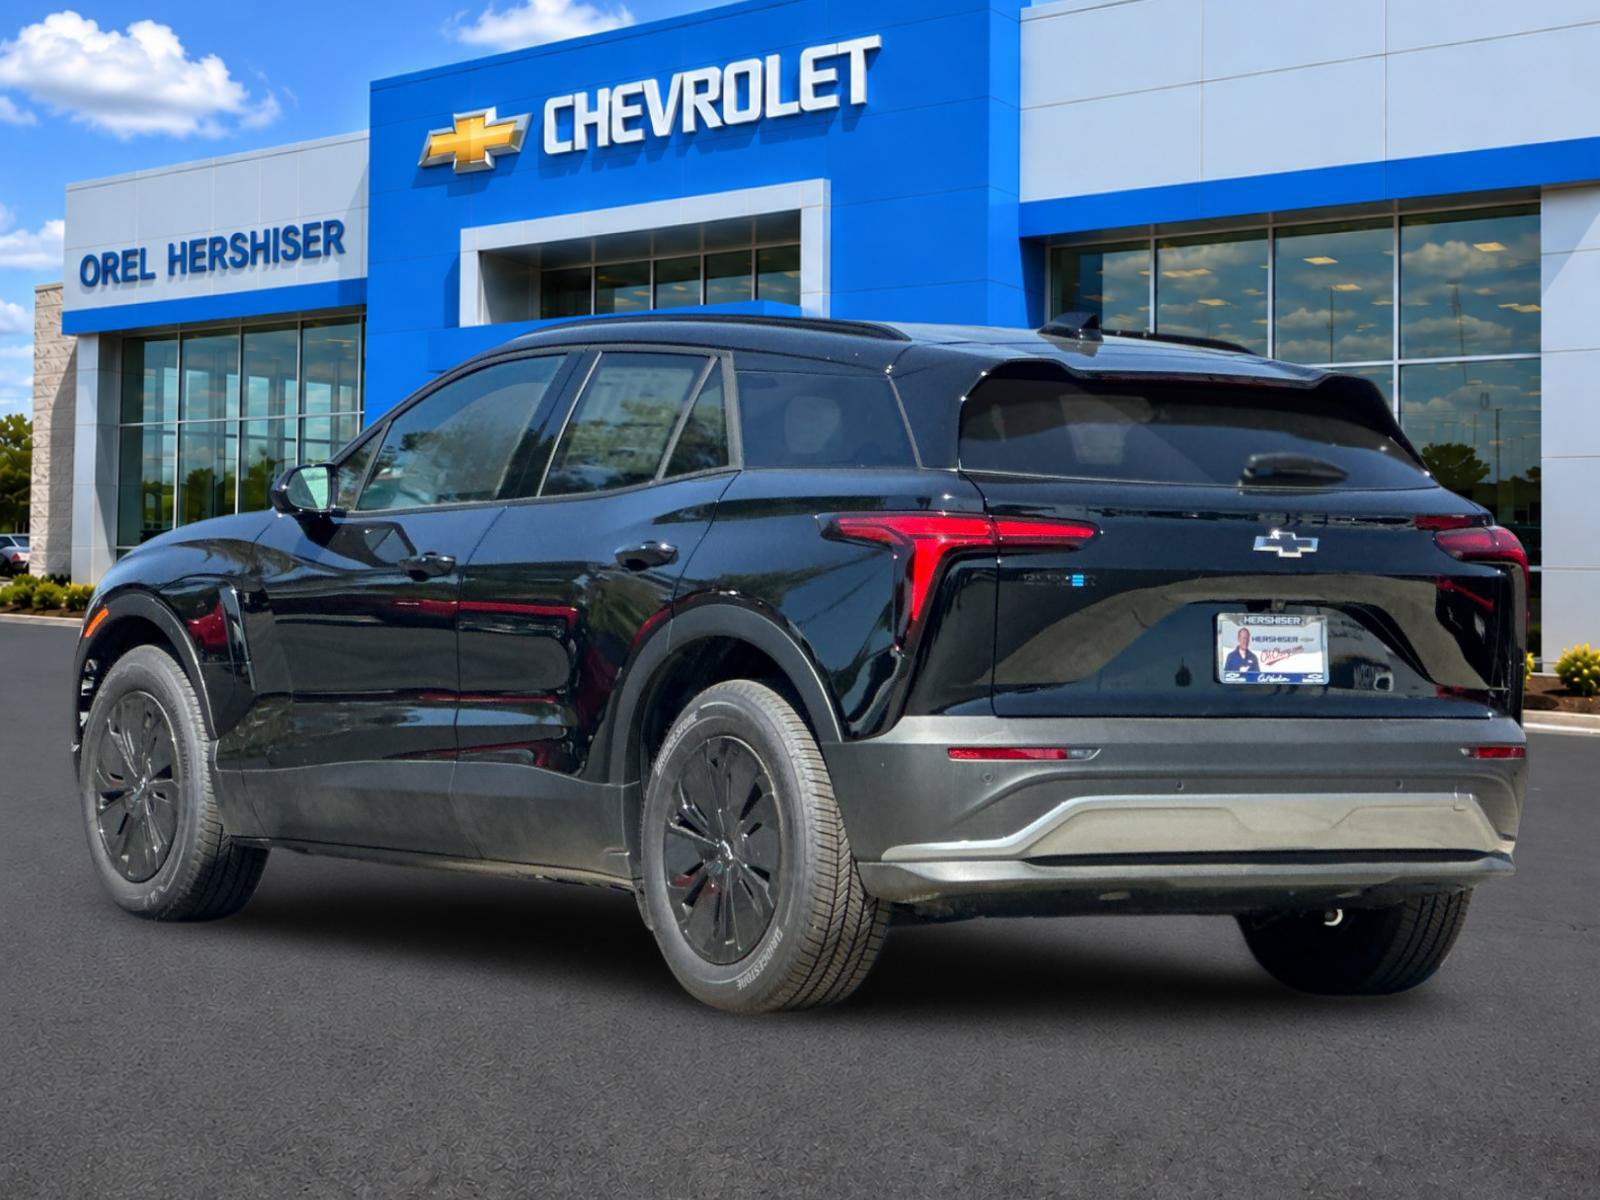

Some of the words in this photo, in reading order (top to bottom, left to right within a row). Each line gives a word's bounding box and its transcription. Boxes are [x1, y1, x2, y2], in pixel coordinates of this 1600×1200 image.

[543, 34, 882, 155] CHEVROLET
[79, 247, 157, 288] OREL
[167, 218, 346, 277] HERSHISER
[1243, 615, 1302, 626] HERSHISER
[1251, 635, 1299, 643] HERSHISER
